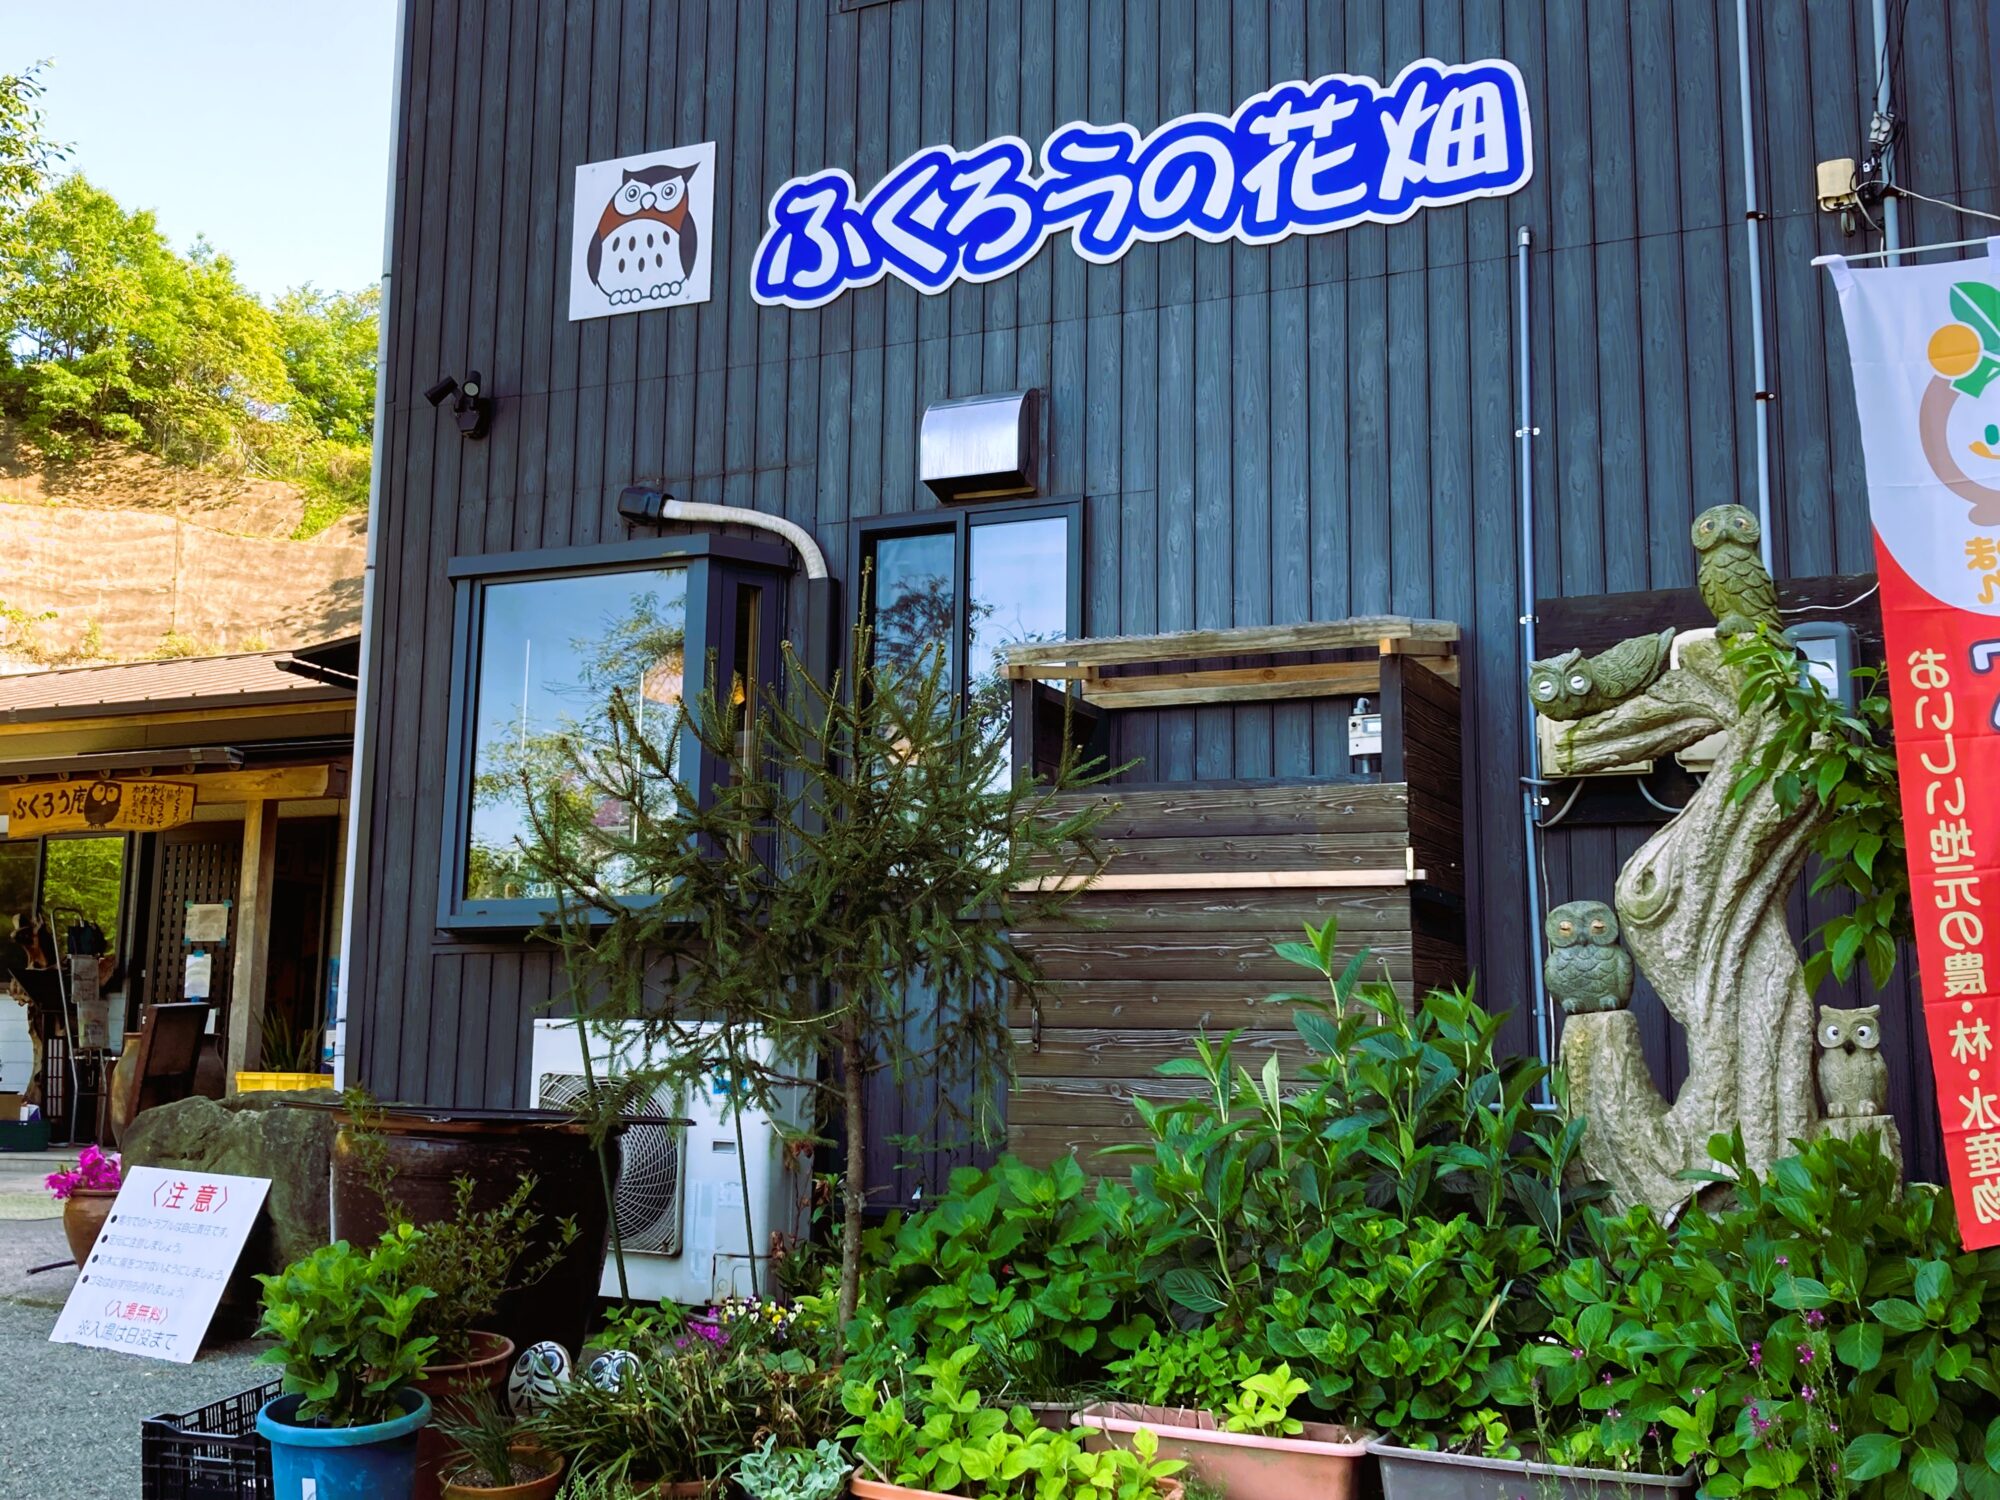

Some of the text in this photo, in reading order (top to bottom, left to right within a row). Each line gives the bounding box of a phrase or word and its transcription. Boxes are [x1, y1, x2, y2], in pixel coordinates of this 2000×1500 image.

[757, 68, 1525, 303] ふくろうの花畑
[13, 785, 86, 820] ふくろう庵
